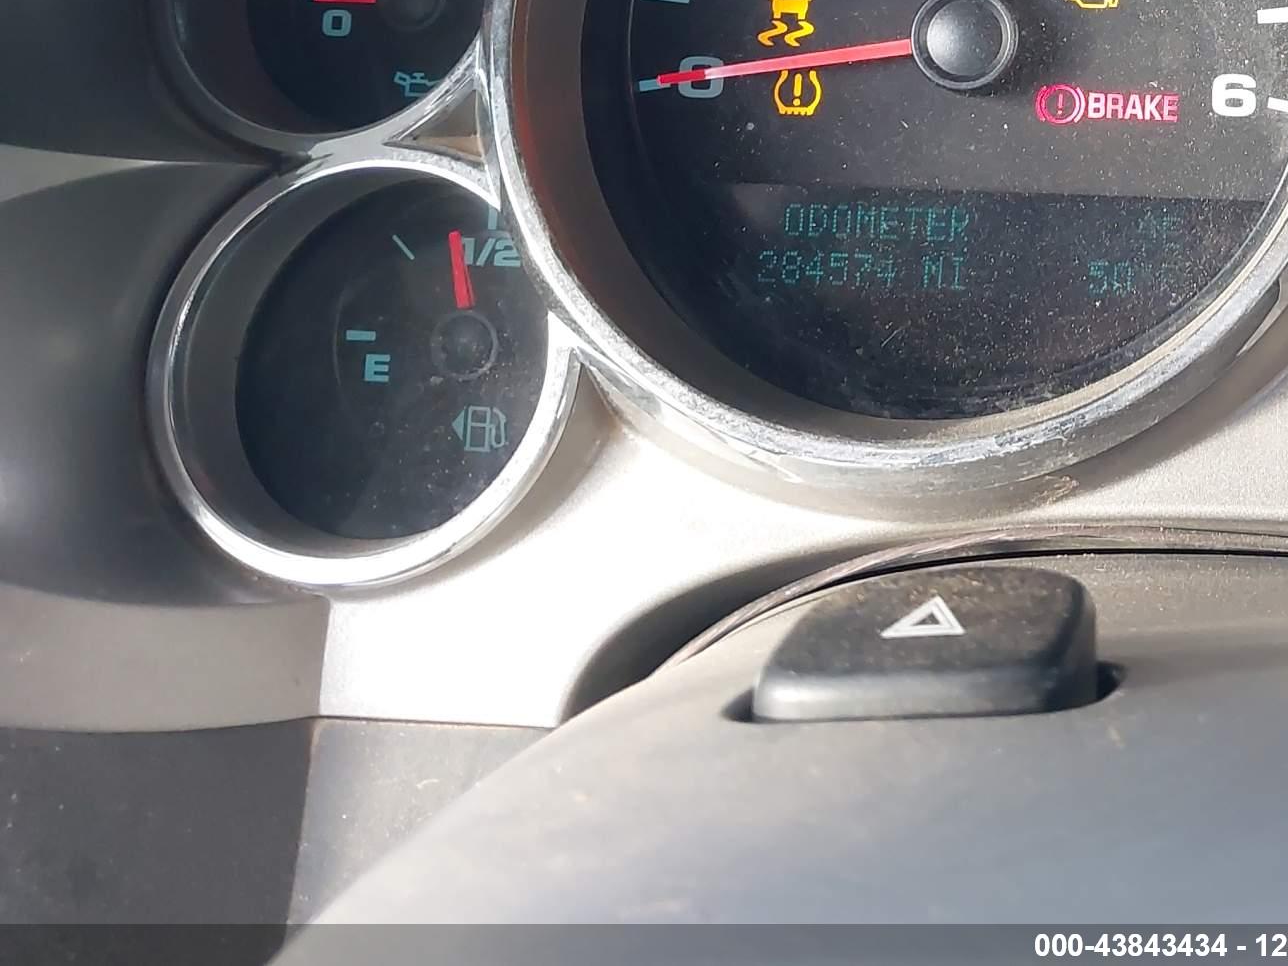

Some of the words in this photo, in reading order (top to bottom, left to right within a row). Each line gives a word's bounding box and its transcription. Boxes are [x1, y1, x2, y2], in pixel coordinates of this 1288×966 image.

[322, 9, 352, 37] 0
[679, 56, 725, 99] 0
[1087, 91, 1180, 122] BRAKE
[1211, 73, 1258, 118] 6
[783, 202, 970, 242] ODOMETER
[462, 236, 521, 267] 1/2
[922, 251, 968, 291] MI
[364, 353, 391, 382] E
